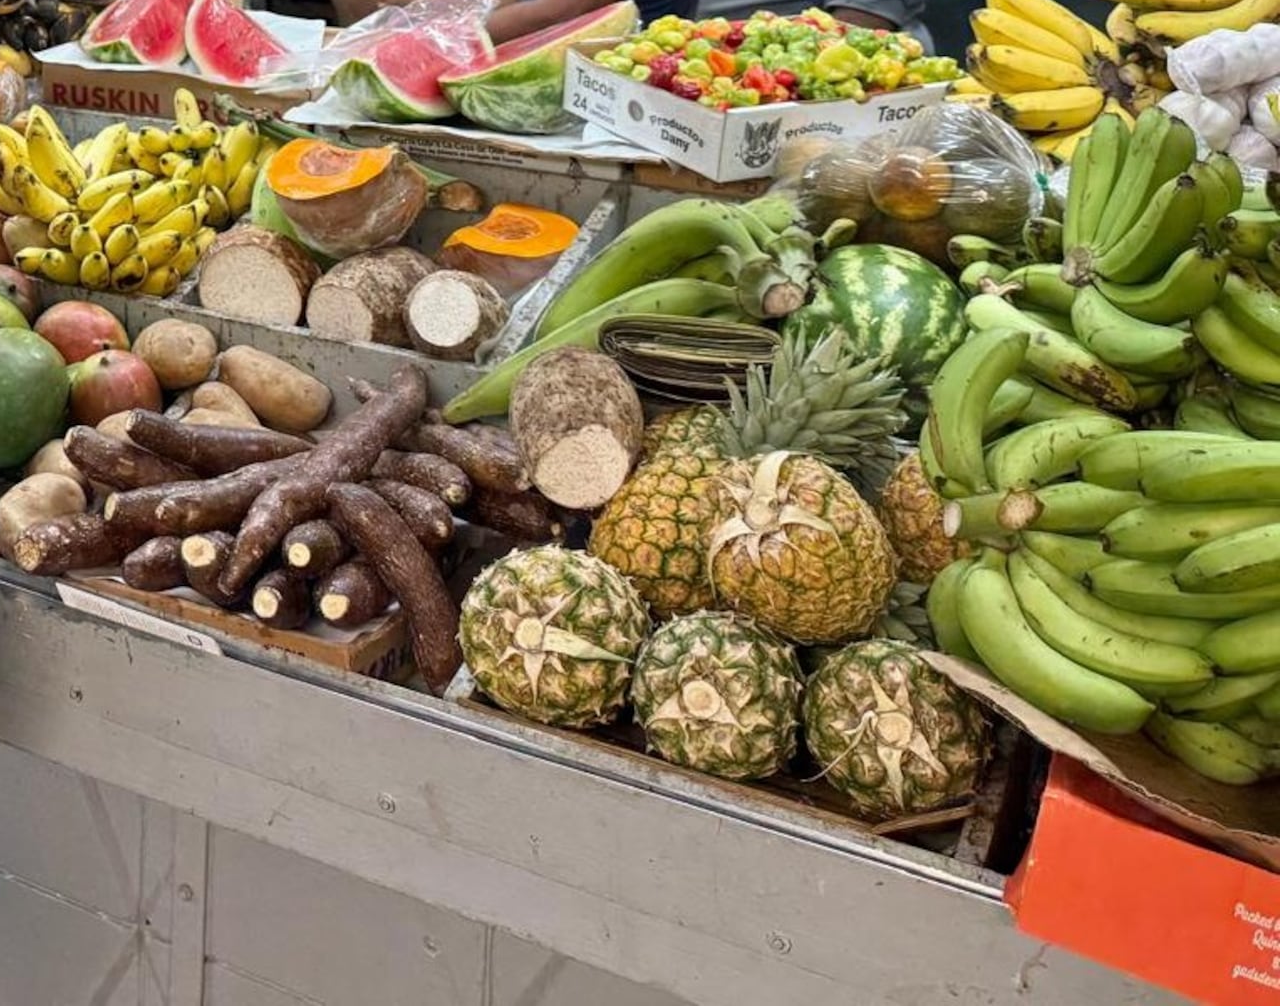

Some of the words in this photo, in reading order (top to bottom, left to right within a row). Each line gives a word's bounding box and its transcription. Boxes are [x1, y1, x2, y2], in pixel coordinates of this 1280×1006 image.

[51, 82, 160, 115] RUSKIN
[573, 93, 588, 111] 24
[649, 114, 705, 149] Productos
[785, 120, 845, 140] Productos
